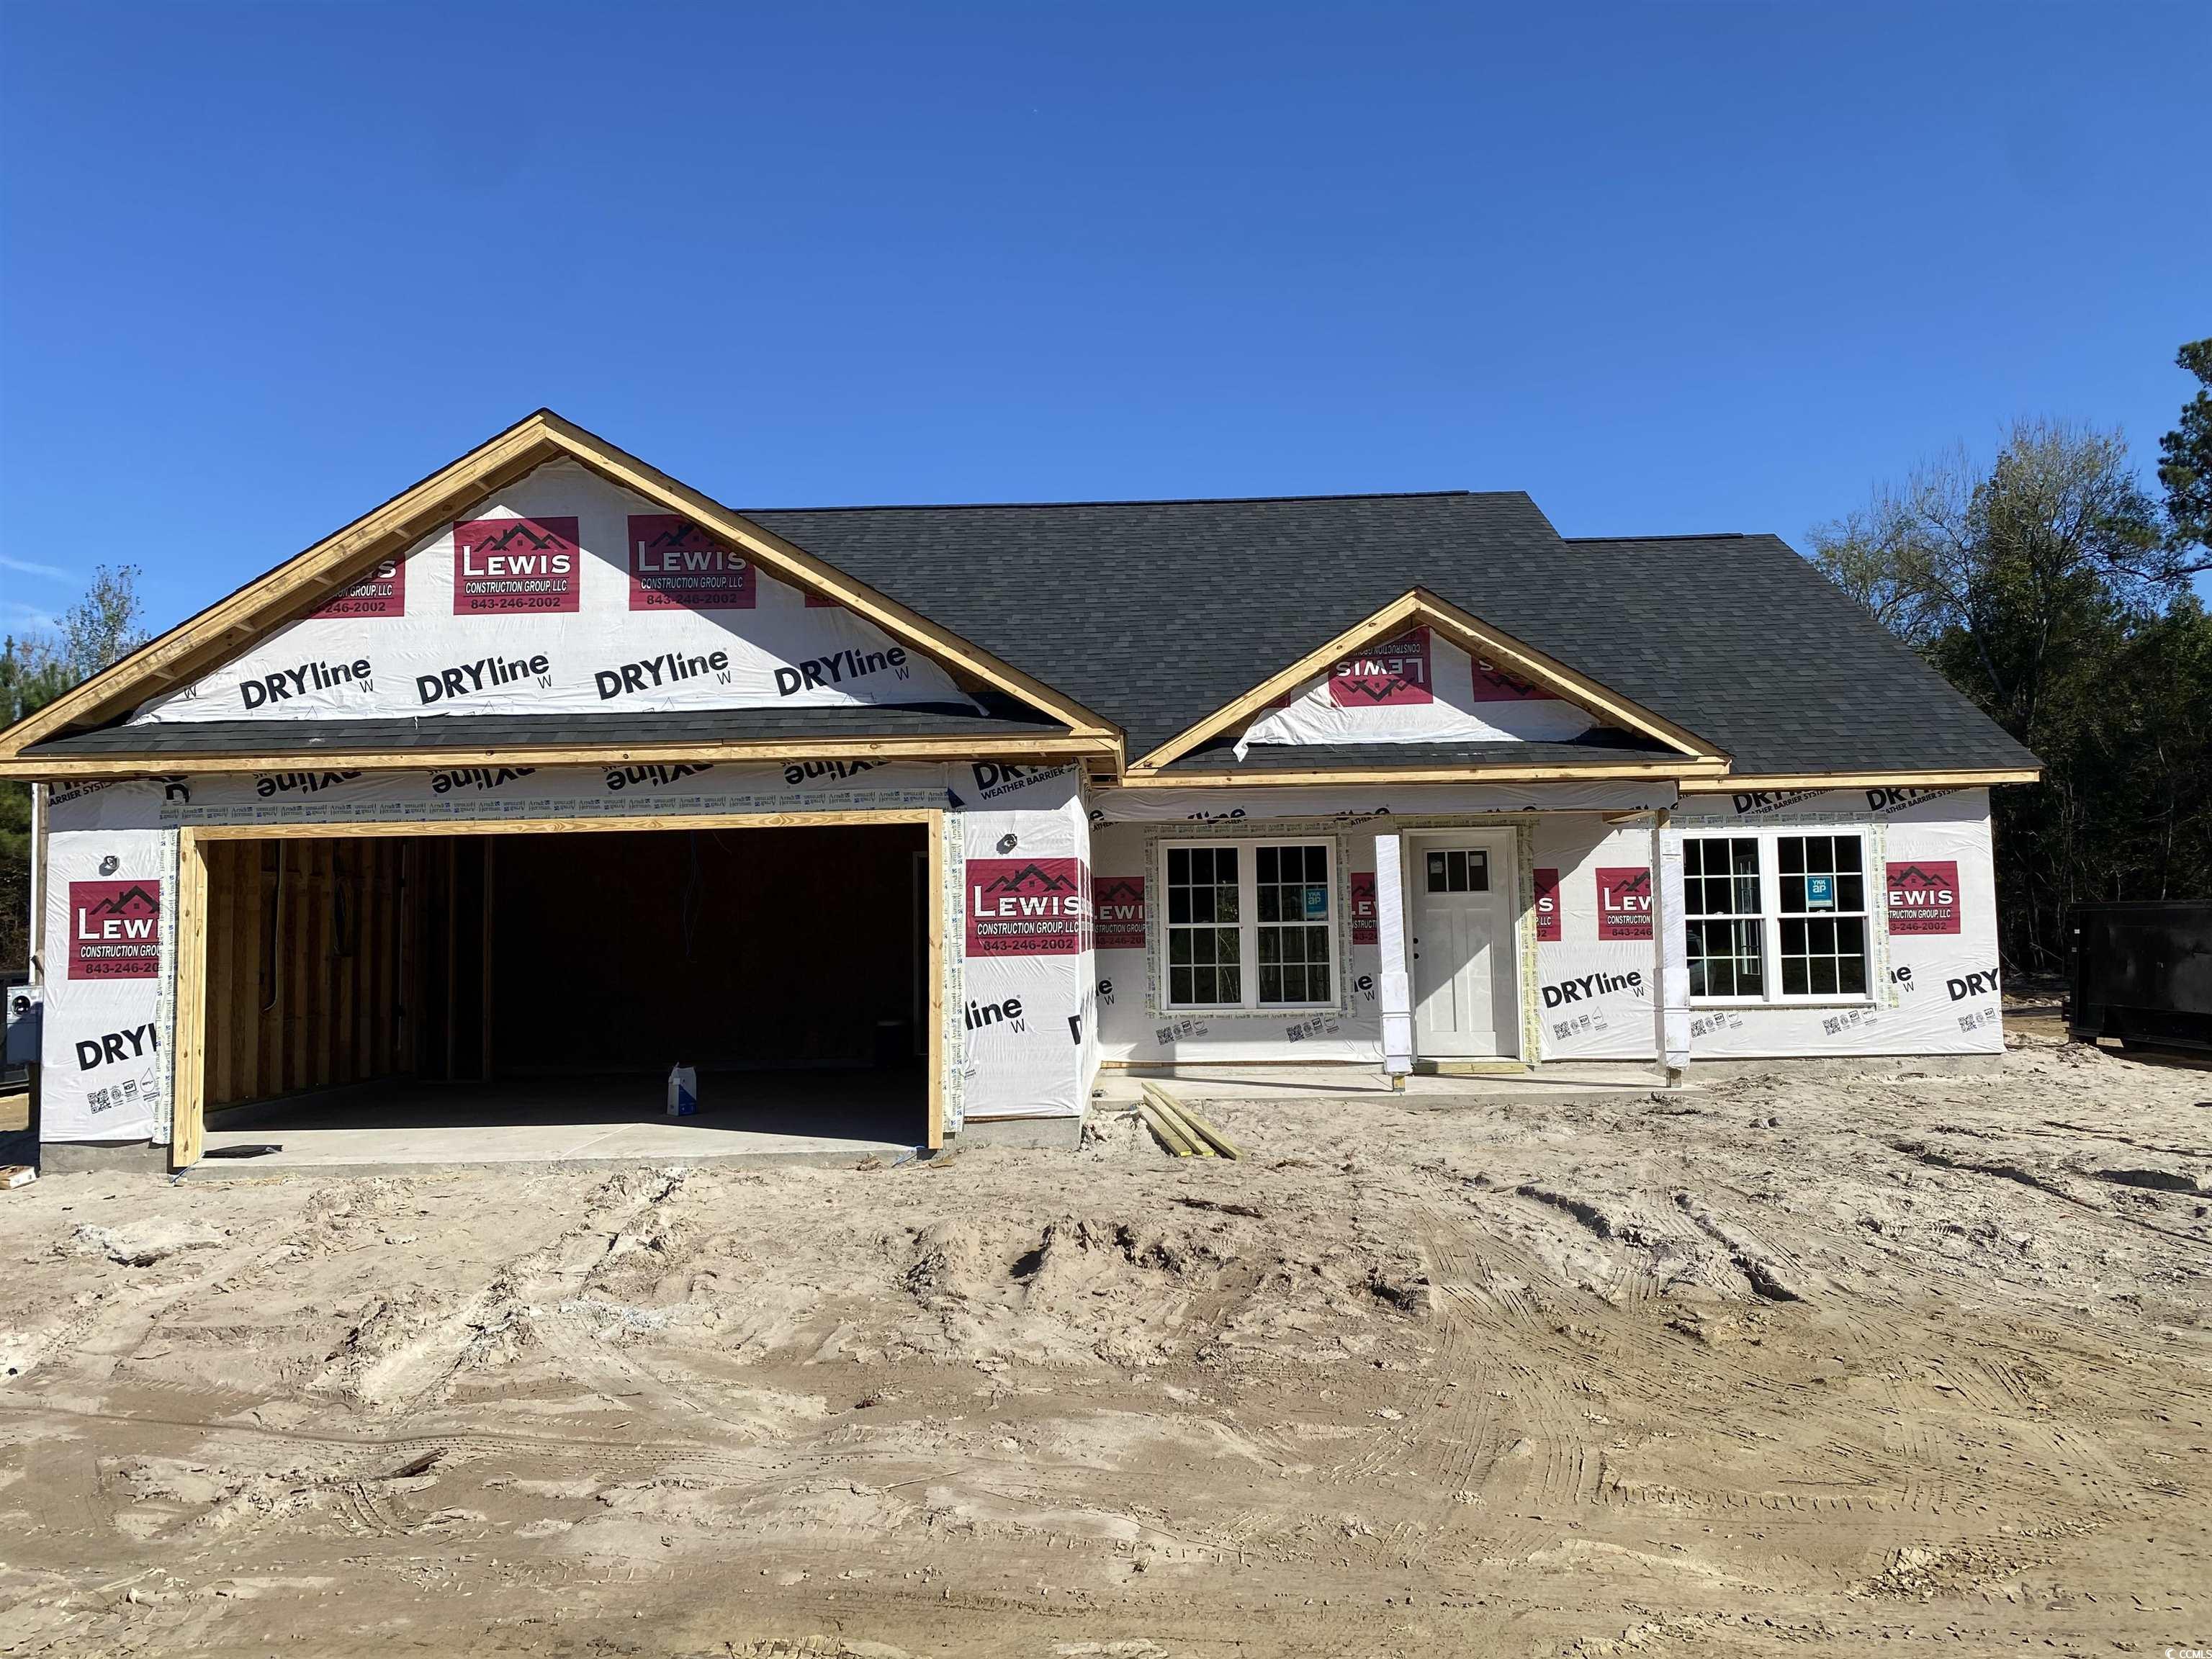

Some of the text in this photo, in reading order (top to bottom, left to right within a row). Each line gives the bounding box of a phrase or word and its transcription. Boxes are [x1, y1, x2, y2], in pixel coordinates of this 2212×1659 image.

[462, 545, 572, 576] LEWIS
[637, 541, 747, 572] LEWIS
[378, 584, 392, 595] LLC
[465, 578, 567, 594] CONSTRUCTION GROUP, LLC
[640, 576, 698, 590] CONSTRUCTION
[728, 575, 743, 588] LLC
[471, 597, 560, 609] 843-246-2002
[647, 593, 737, 606] 843-246-2002
[595, 651, 729, 700] DRYline
[773, 647, 907, 697] DRYline
[1336, 657, 1424, 684] LEWIS
[240, 659, 371, 709] DRYline
[416, 655, 549, 705] DRYline
[48, 790, 81, 806] ARRIER
[981, 780, 1025, 800] WEATHER
[1774, 795, 1803, 810] BARRIER
[1881, 802, 1907, 814] ATHER
[1908, 793, 1937, 808] BARRIER
[974, 885, 1082, 917] LEWIS
[1094, 904, 1143, 920] EWI
[1607, 914, 1650, 925] CONSTRUCTION
[1889, 909, 1917, 919] TRUCTION
[1940, 909, 1951, 918] LLC
[977, 922, 1035, 935] CONSTRUCTION
[1065, 921, 1079, 933] LLC
[1094, 924, 1125, 933] STRUCTION
[1540, 916, 1552, 926] LLC
[81, 945, 138, 958] CONSTRUCTION
[984, 939, 1074, 950] 843-246-2002
[1542, 971, 1642, 1008] DRYline
